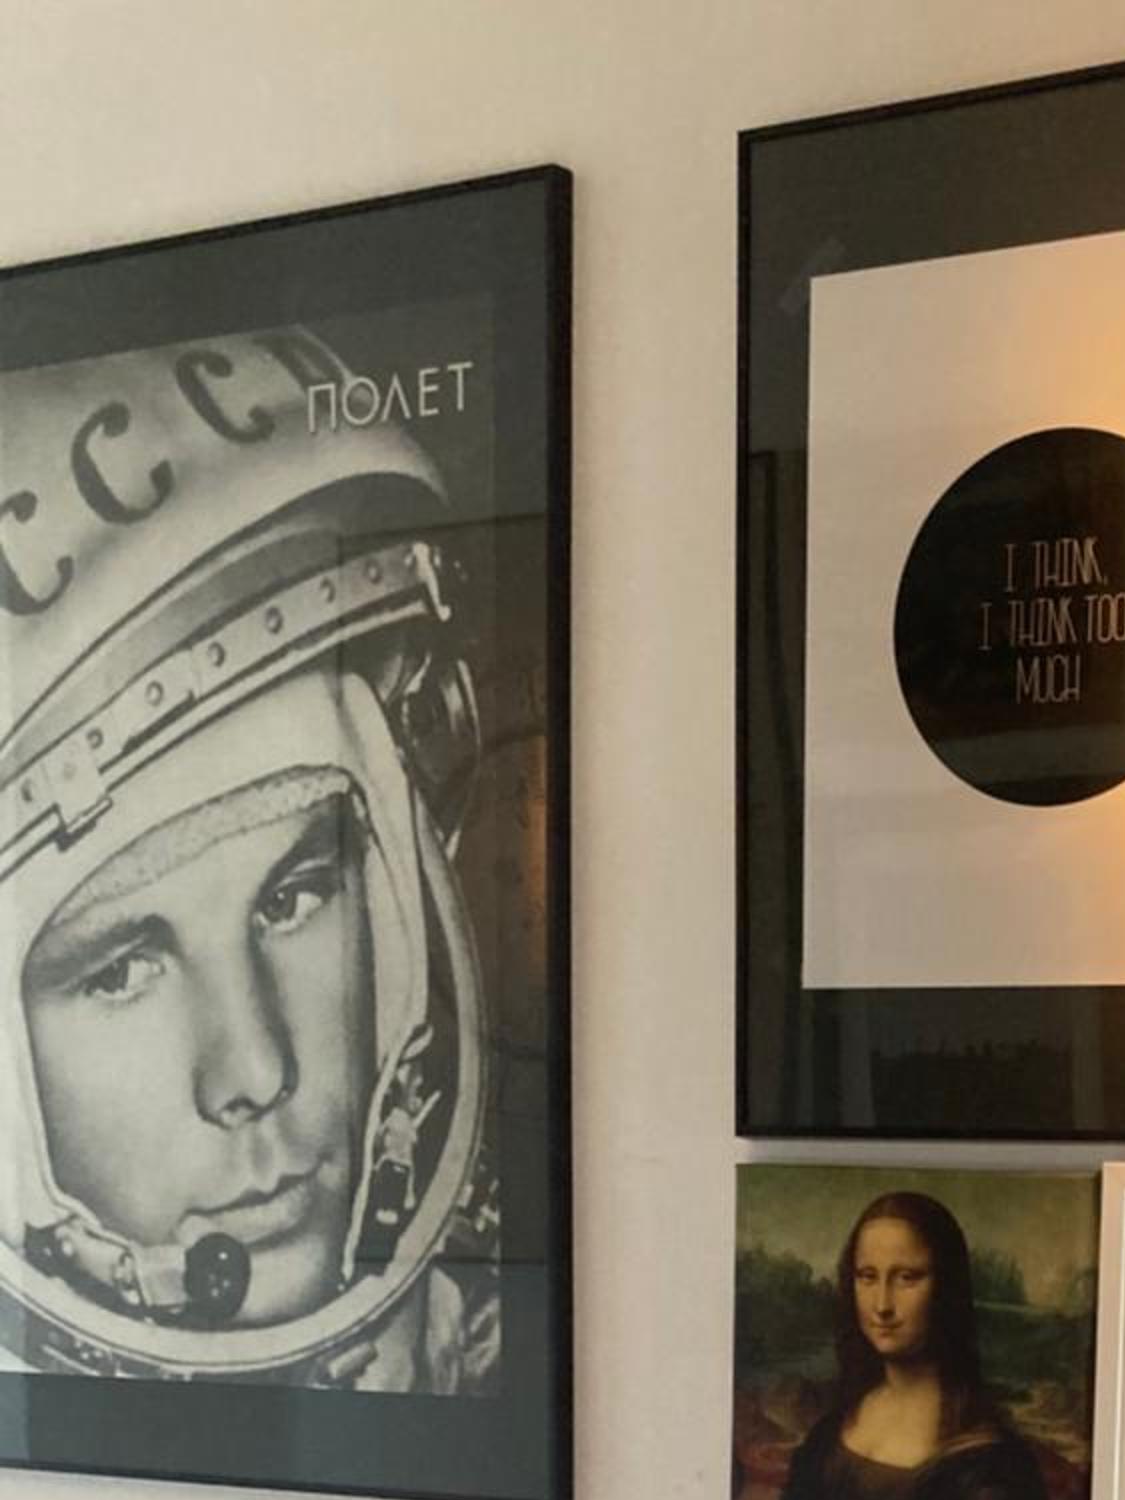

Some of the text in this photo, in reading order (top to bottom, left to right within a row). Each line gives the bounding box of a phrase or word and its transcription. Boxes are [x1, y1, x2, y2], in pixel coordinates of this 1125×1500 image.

[307, 361, 475, 433] ПОЛЕТ
[1004, 542, 1017, 592] I
[979, 602, 993, 651] I
[1008, 597, 1078, 647] THINK
[1015, 653, 1081, 704] MUCH
